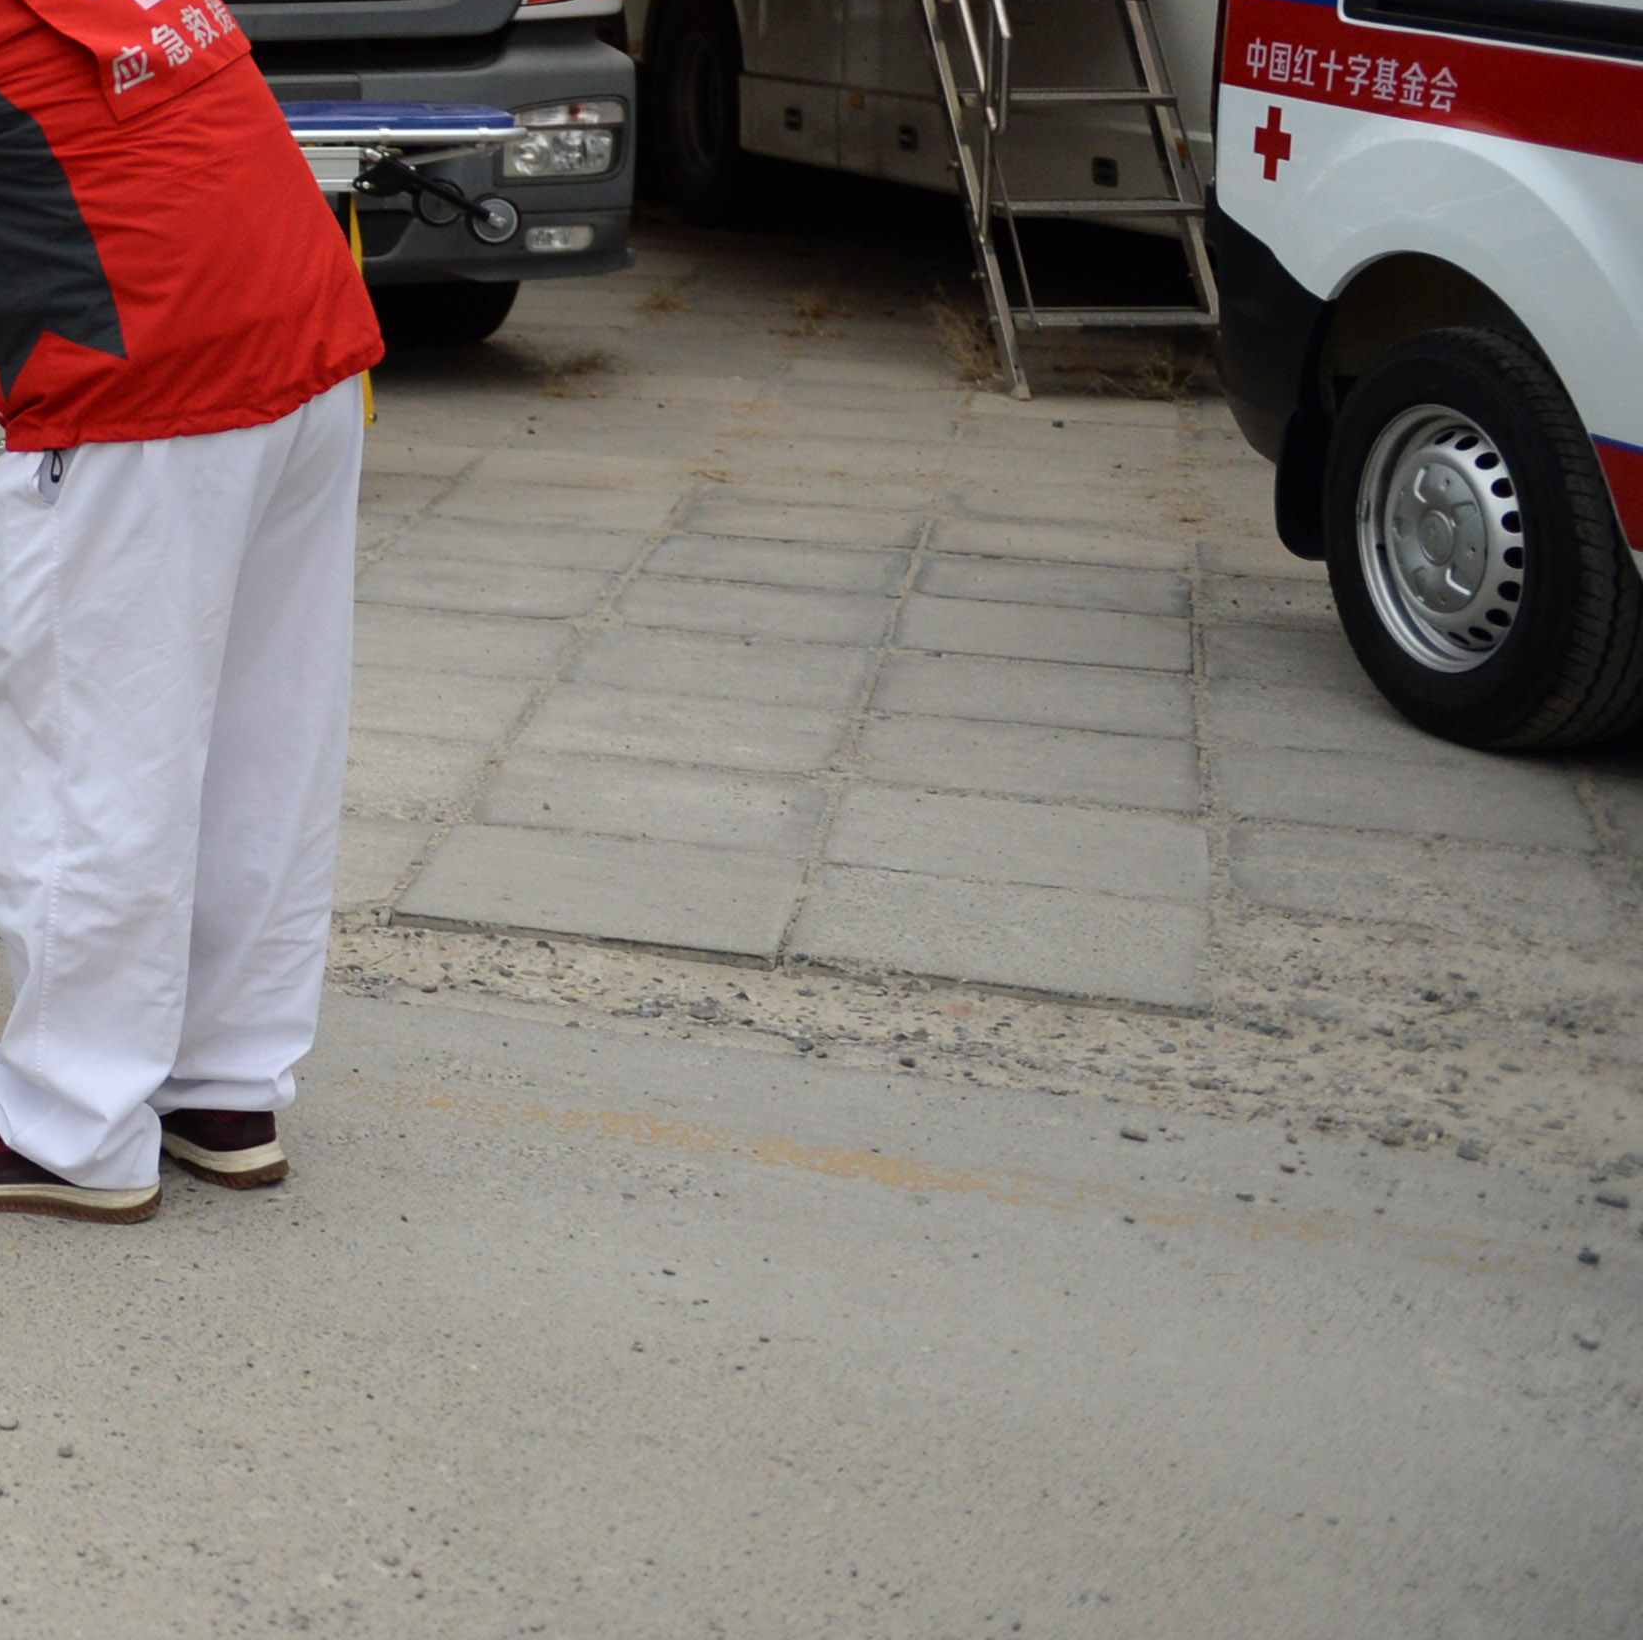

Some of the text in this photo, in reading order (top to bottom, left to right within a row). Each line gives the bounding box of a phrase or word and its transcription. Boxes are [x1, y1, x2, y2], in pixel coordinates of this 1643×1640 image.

[1245, 37, 1459, 114] 中国红十字基金会
